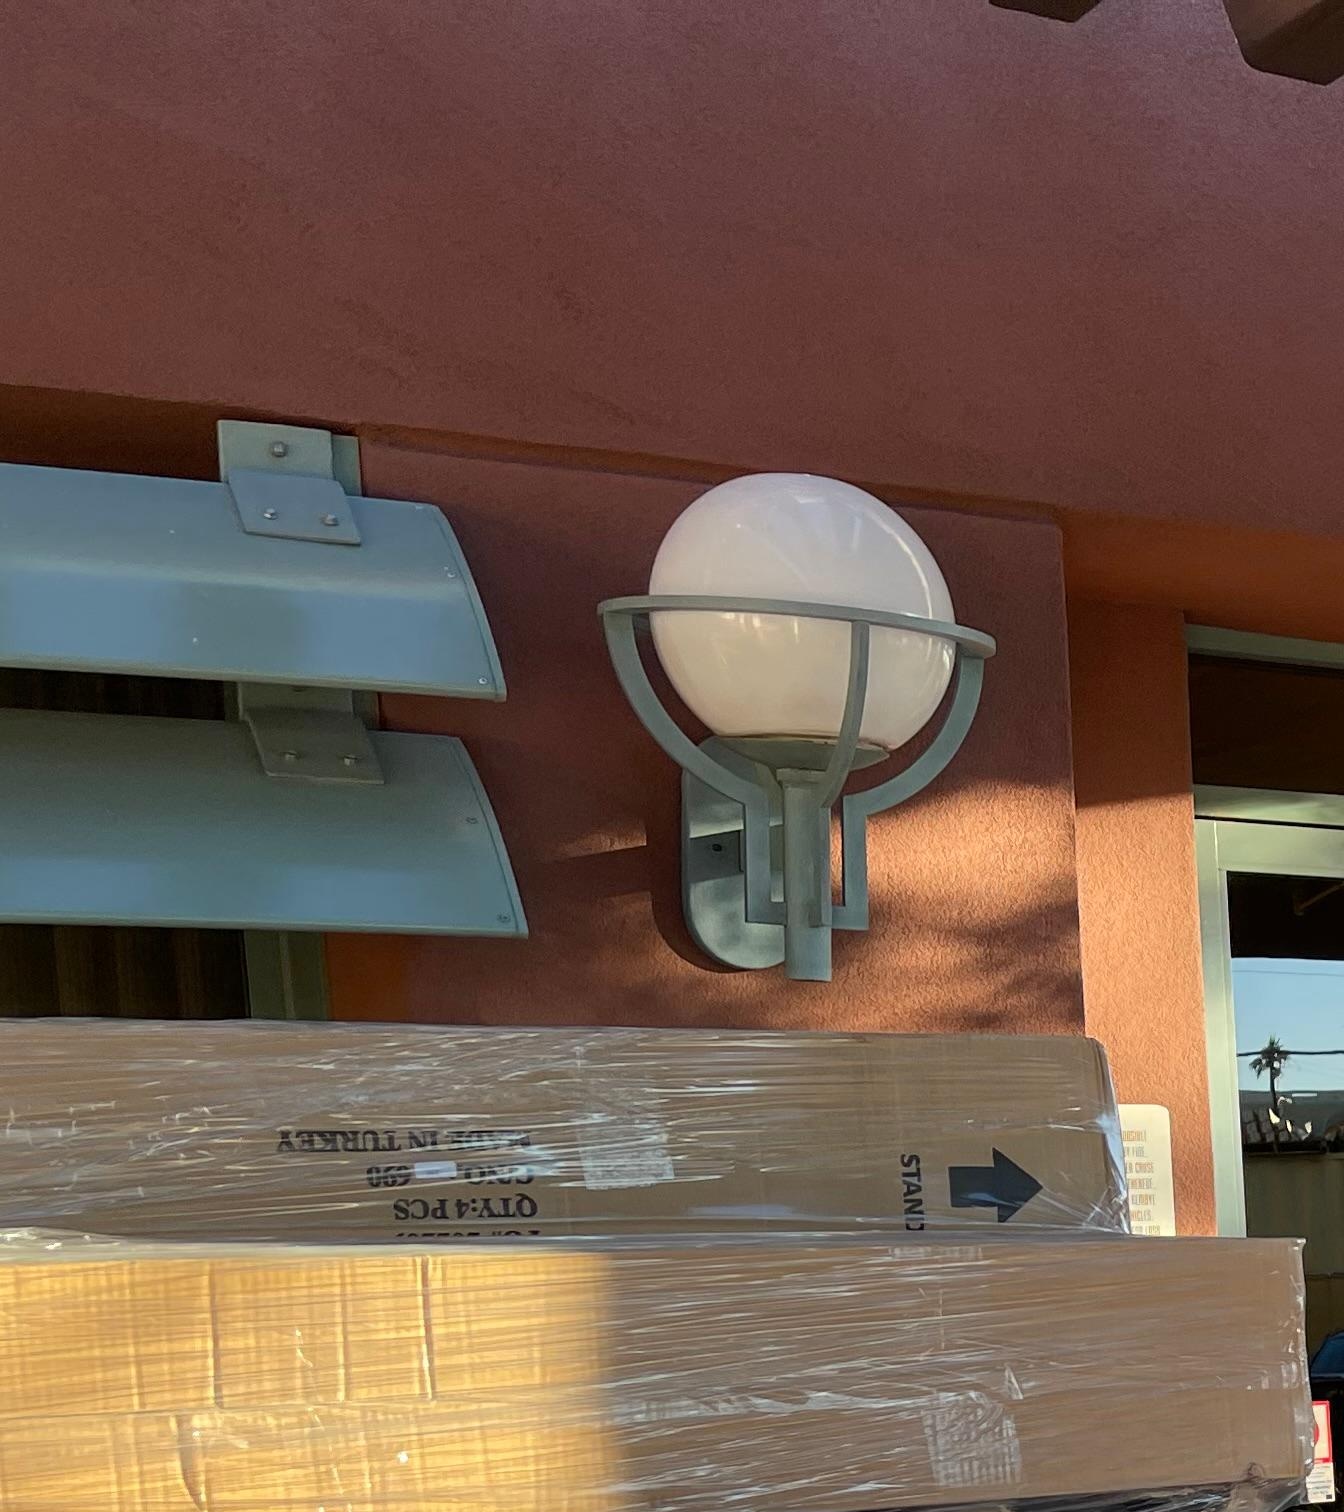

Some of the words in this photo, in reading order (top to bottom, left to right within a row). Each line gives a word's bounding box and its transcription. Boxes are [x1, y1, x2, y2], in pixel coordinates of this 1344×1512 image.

[277, 1129, 401, 1152] TURKEY
[409, 1130, 438, 1150] IN
[900, 1154, 925, 1231] STAND
[393, 1197, 450, 1220] PCS
